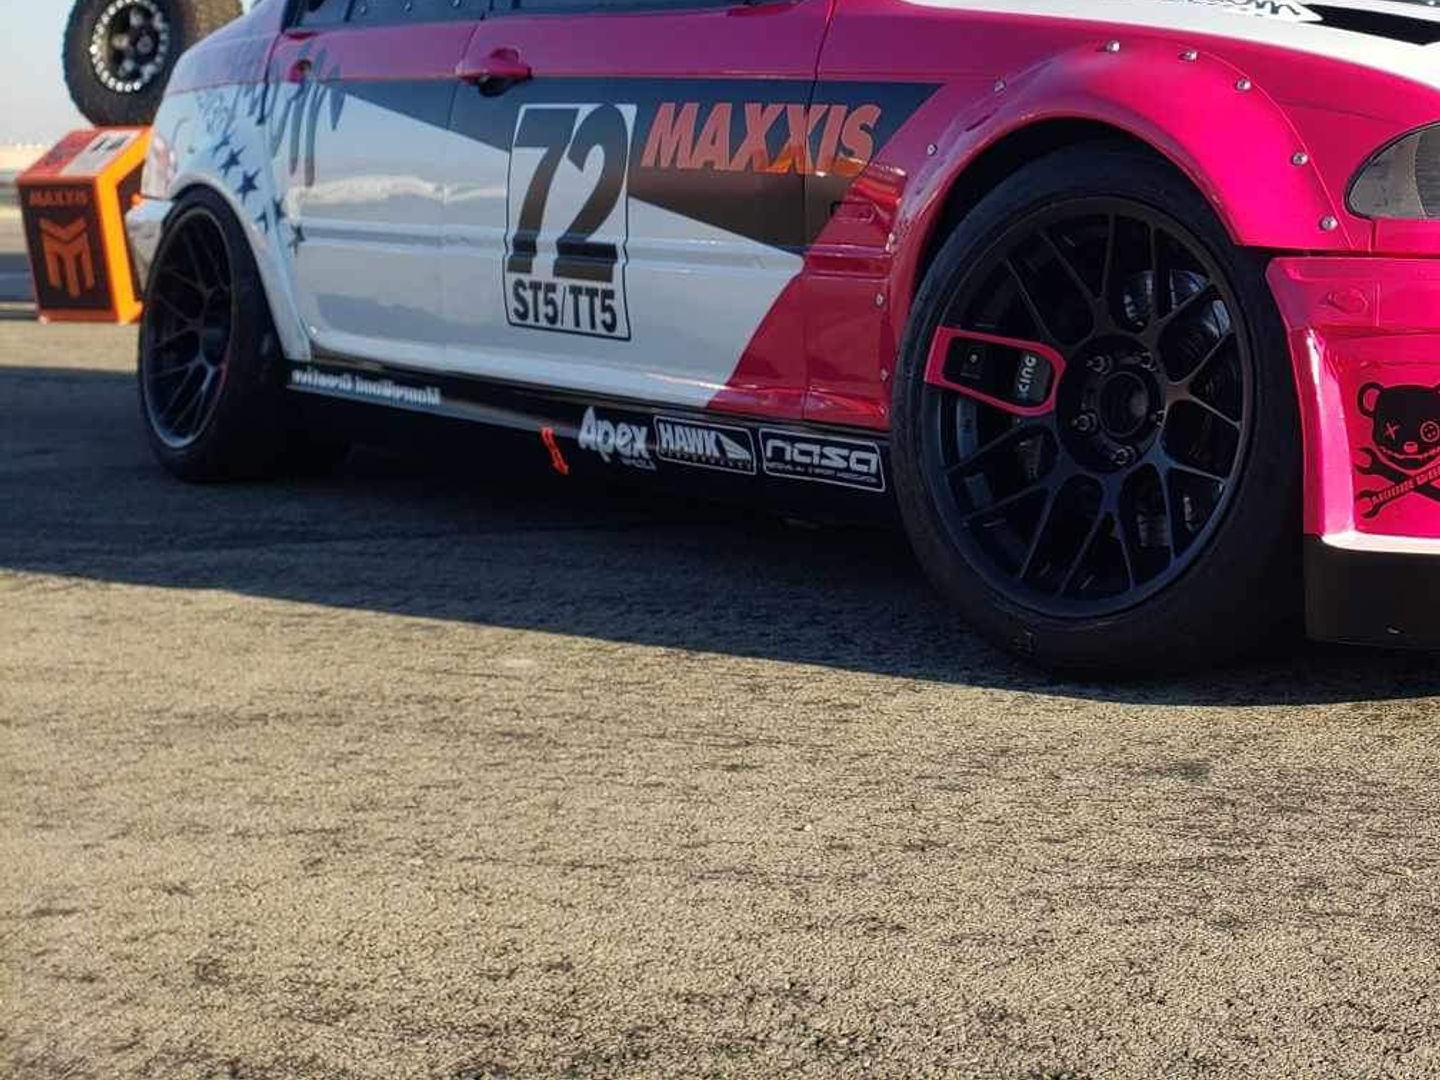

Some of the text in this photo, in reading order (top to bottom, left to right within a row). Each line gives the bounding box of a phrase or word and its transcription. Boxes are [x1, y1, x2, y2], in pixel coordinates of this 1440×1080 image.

[641, 102, 882, 177] MAXXIS
[507, 104, 628, 282] 72
[512, 278, 618, 333] ST5/TT5
[578, 406, 650, 462] Apex
[658, 421, 721, 457] HAWK
